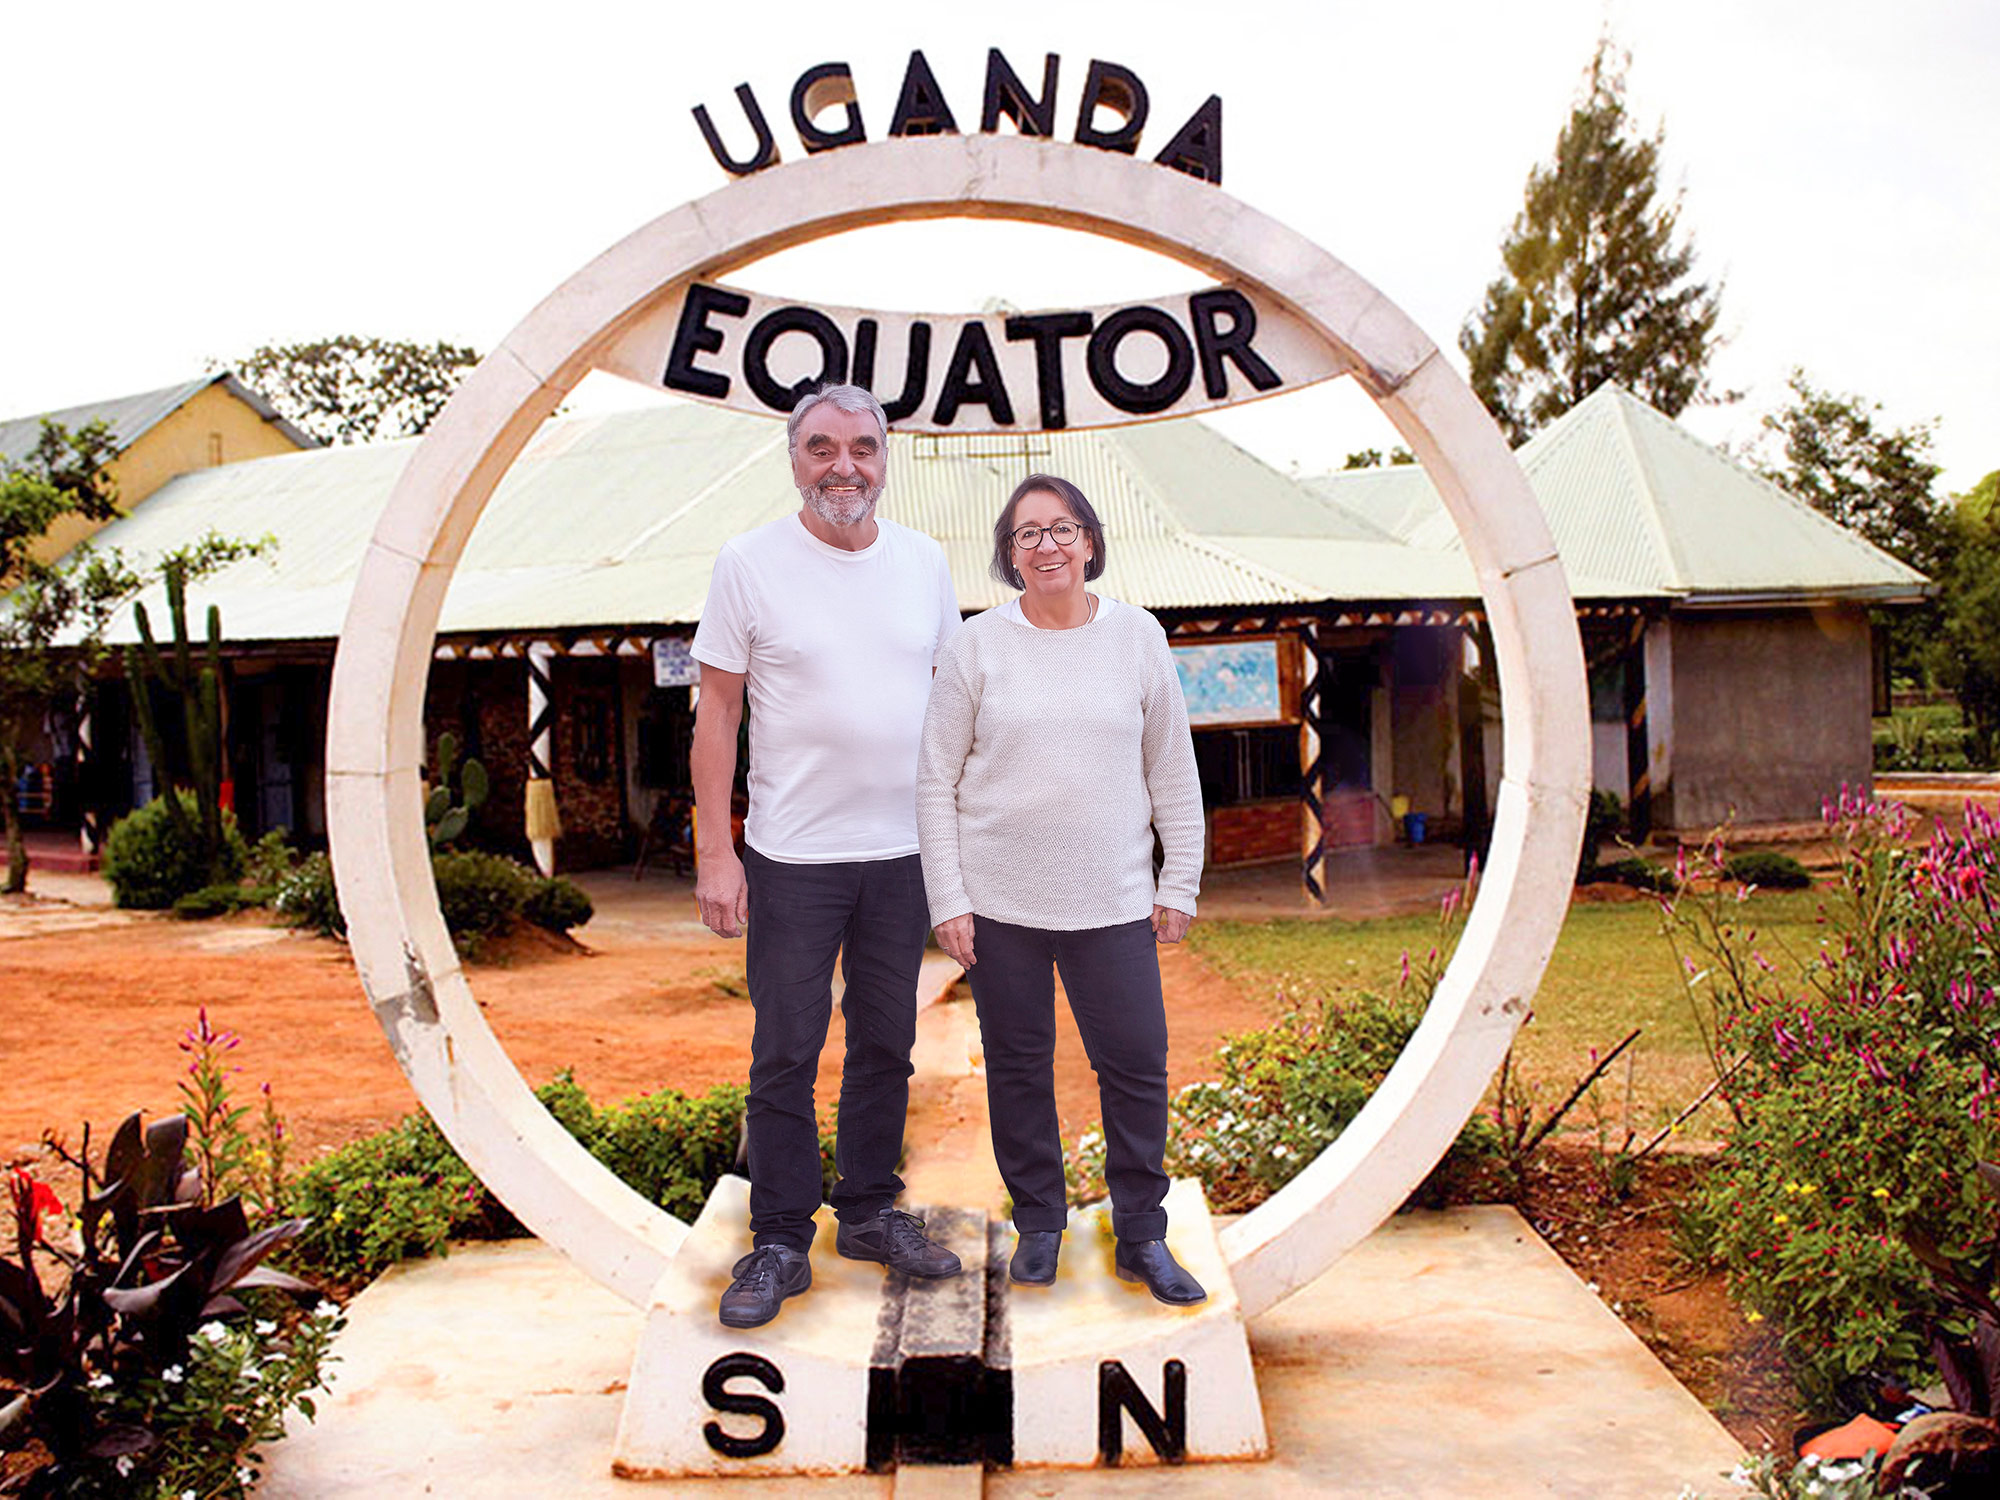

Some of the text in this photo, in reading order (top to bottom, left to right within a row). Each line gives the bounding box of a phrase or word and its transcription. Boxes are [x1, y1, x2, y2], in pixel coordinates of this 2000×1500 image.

[691, 47, 1223, 185] UGANDA
[664, 283, 1283, 430] EQUATOR
[702, 1352, 1187, 1466] S N
